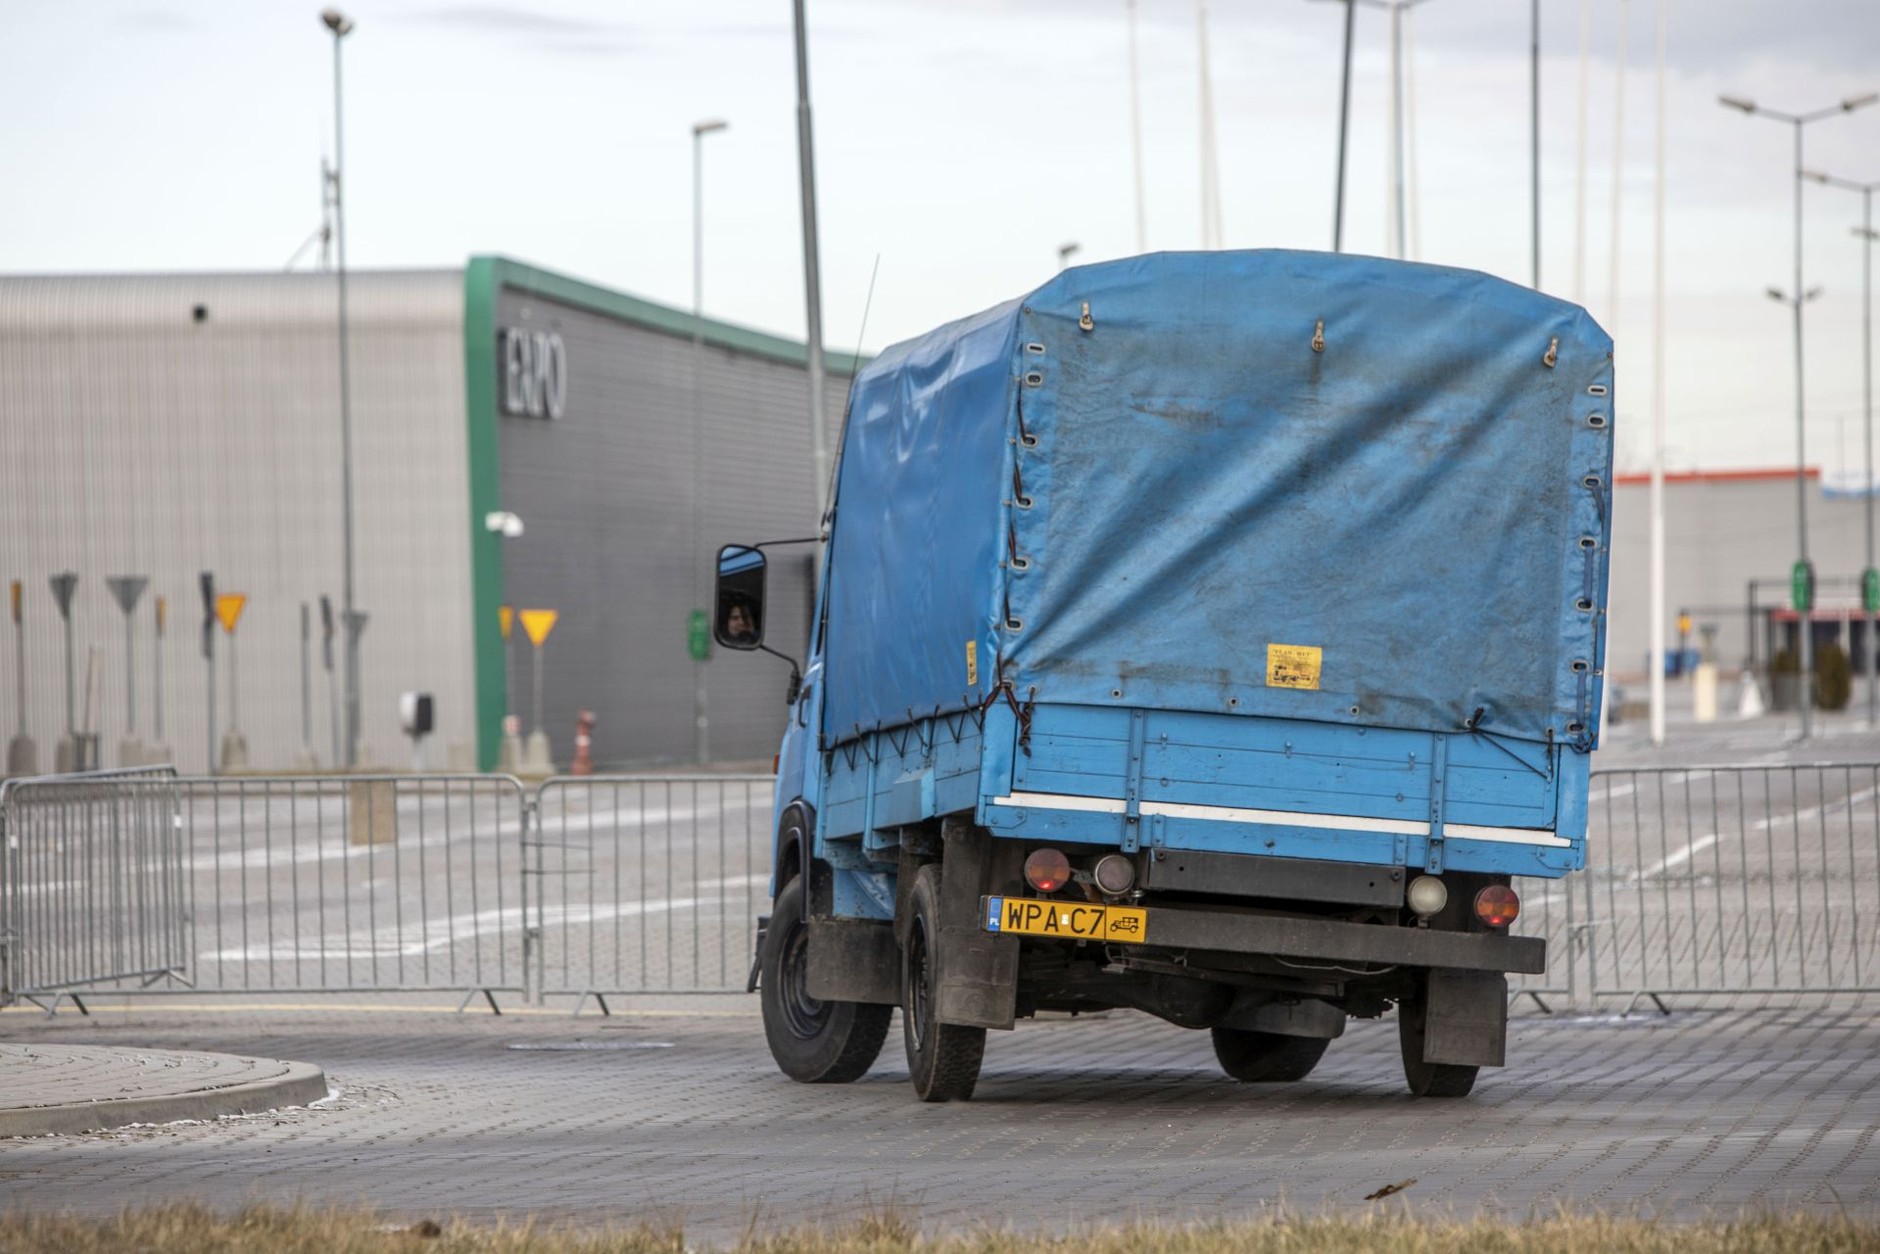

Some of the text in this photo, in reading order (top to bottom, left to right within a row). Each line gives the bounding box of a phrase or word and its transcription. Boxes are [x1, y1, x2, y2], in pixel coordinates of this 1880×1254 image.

[507, 327, 567, 419] EXPO
[989, 917, 1000, 926] PL
[1008, 902, 1105, 935] WPA C7
